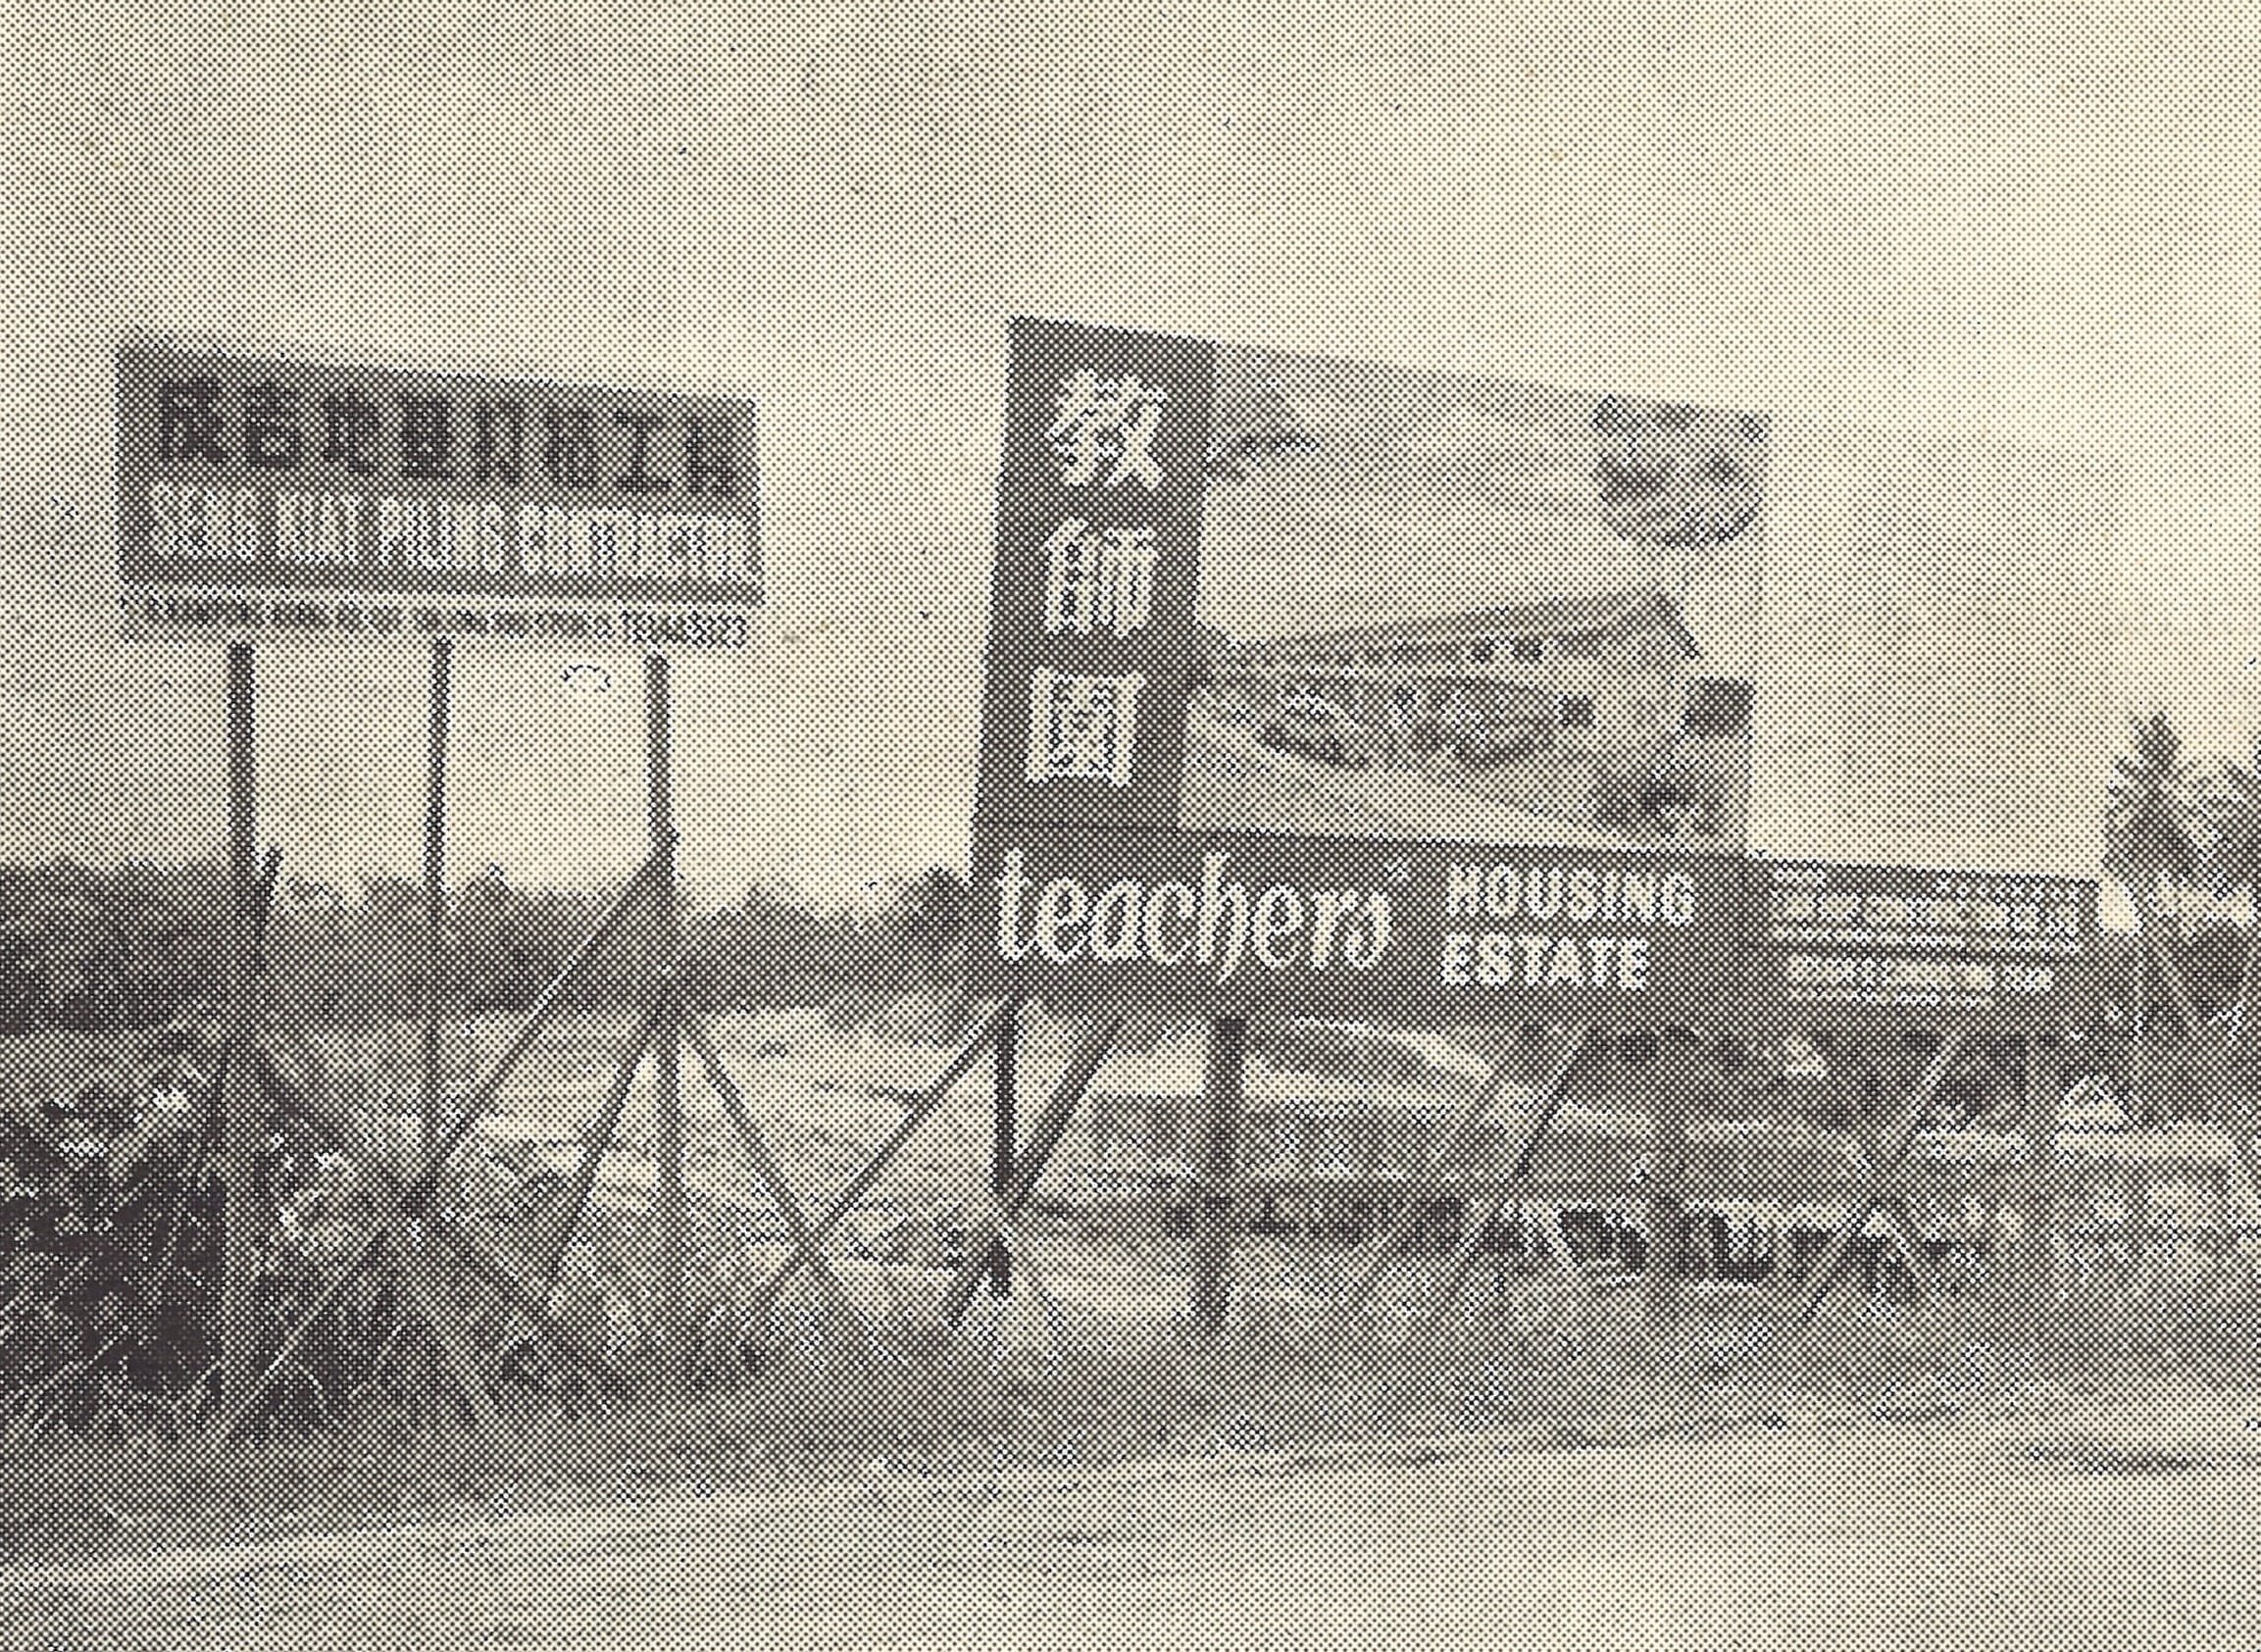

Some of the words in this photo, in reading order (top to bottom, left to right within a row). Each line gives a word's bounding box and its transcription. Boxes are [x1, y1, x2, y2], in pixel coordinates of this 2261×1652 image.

[149, 481, 257, 560] SENG
[276, 489, 361, 566] KIAT
[379, 496, 506, 575] PILING
[1023, 367, 1169, 788] 教師園
[1444, 863, 1696, 926] HOUSING
[1439, 931, 1651, 992] ESTATE
